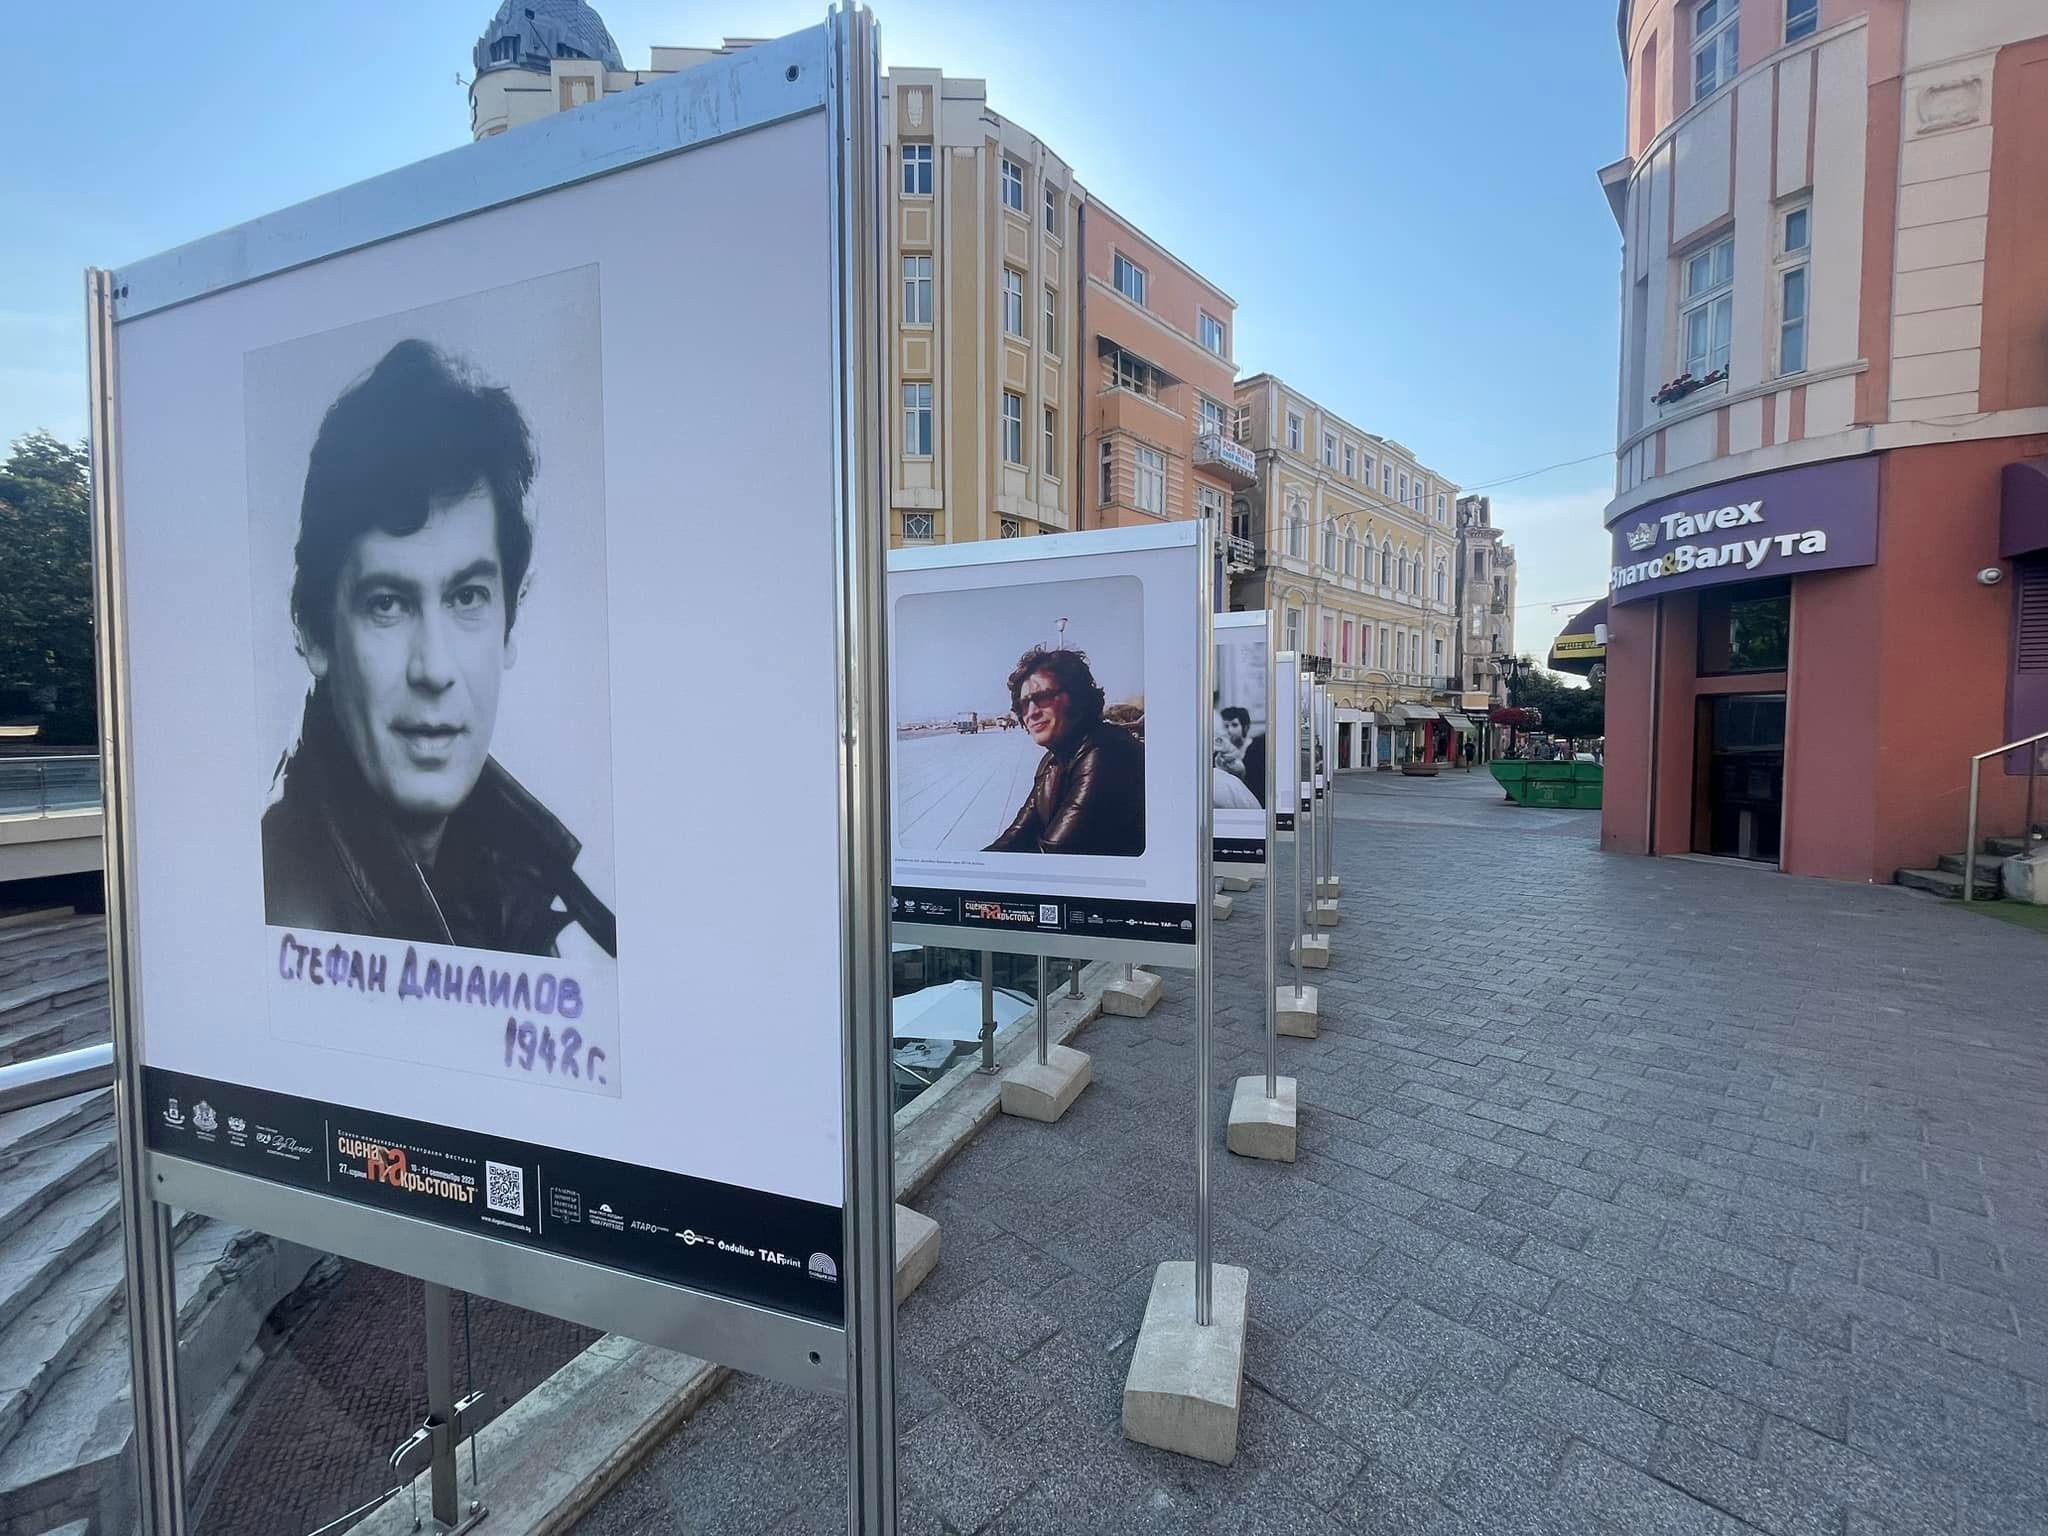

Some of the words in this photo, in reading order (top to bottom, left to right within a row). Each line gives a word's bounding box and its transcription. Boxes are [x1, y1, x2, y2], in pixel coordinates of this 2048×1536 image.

[1660, 500, 1765, 541] Tavex
[279, 933, 387, 993] СТЕФАН
[397, 946, 584, 1019] ДАНАИЛОВ
[338, 1137, 379, 1160] сцена
